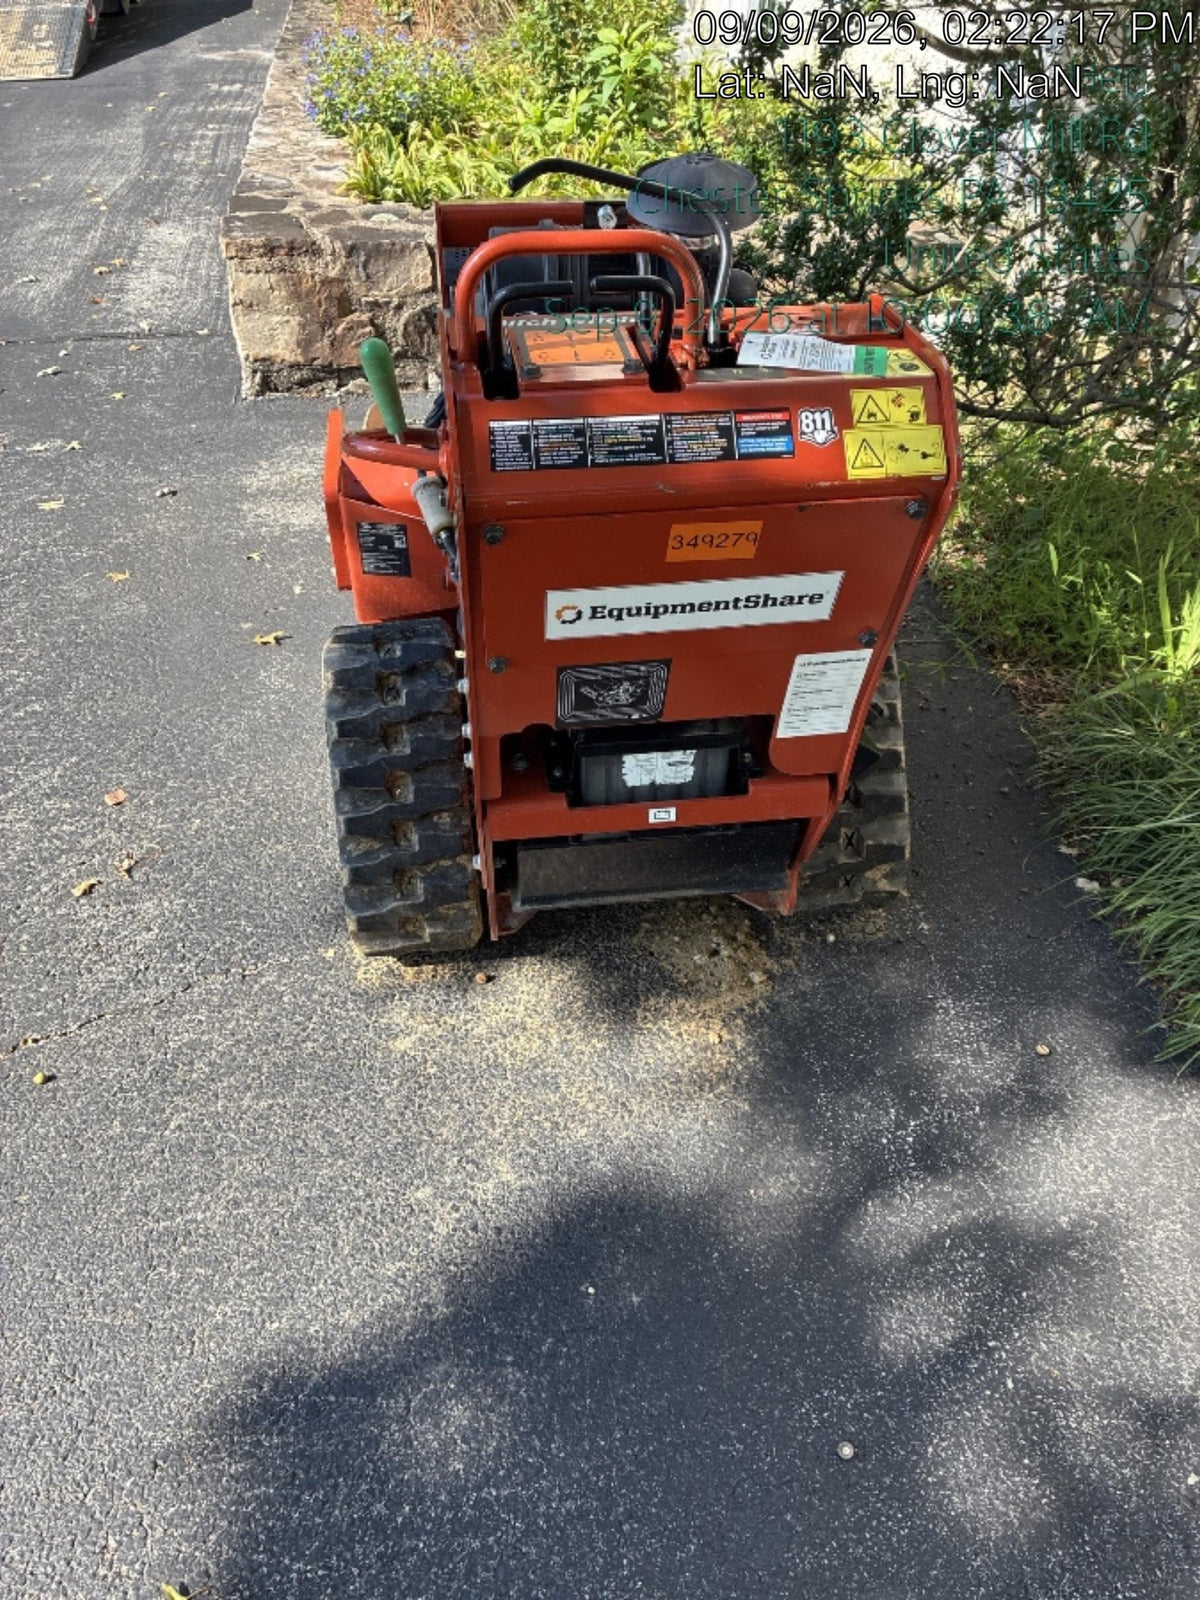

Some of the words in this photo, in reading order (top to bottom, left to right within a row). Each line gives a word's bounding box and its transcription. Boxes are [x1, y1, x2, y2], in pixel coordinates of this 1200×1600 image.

[800, 409, 832, 433] 811
[671, 531, 759, 550] 349279
[588, 591, 826, 622] EquipmentShare
